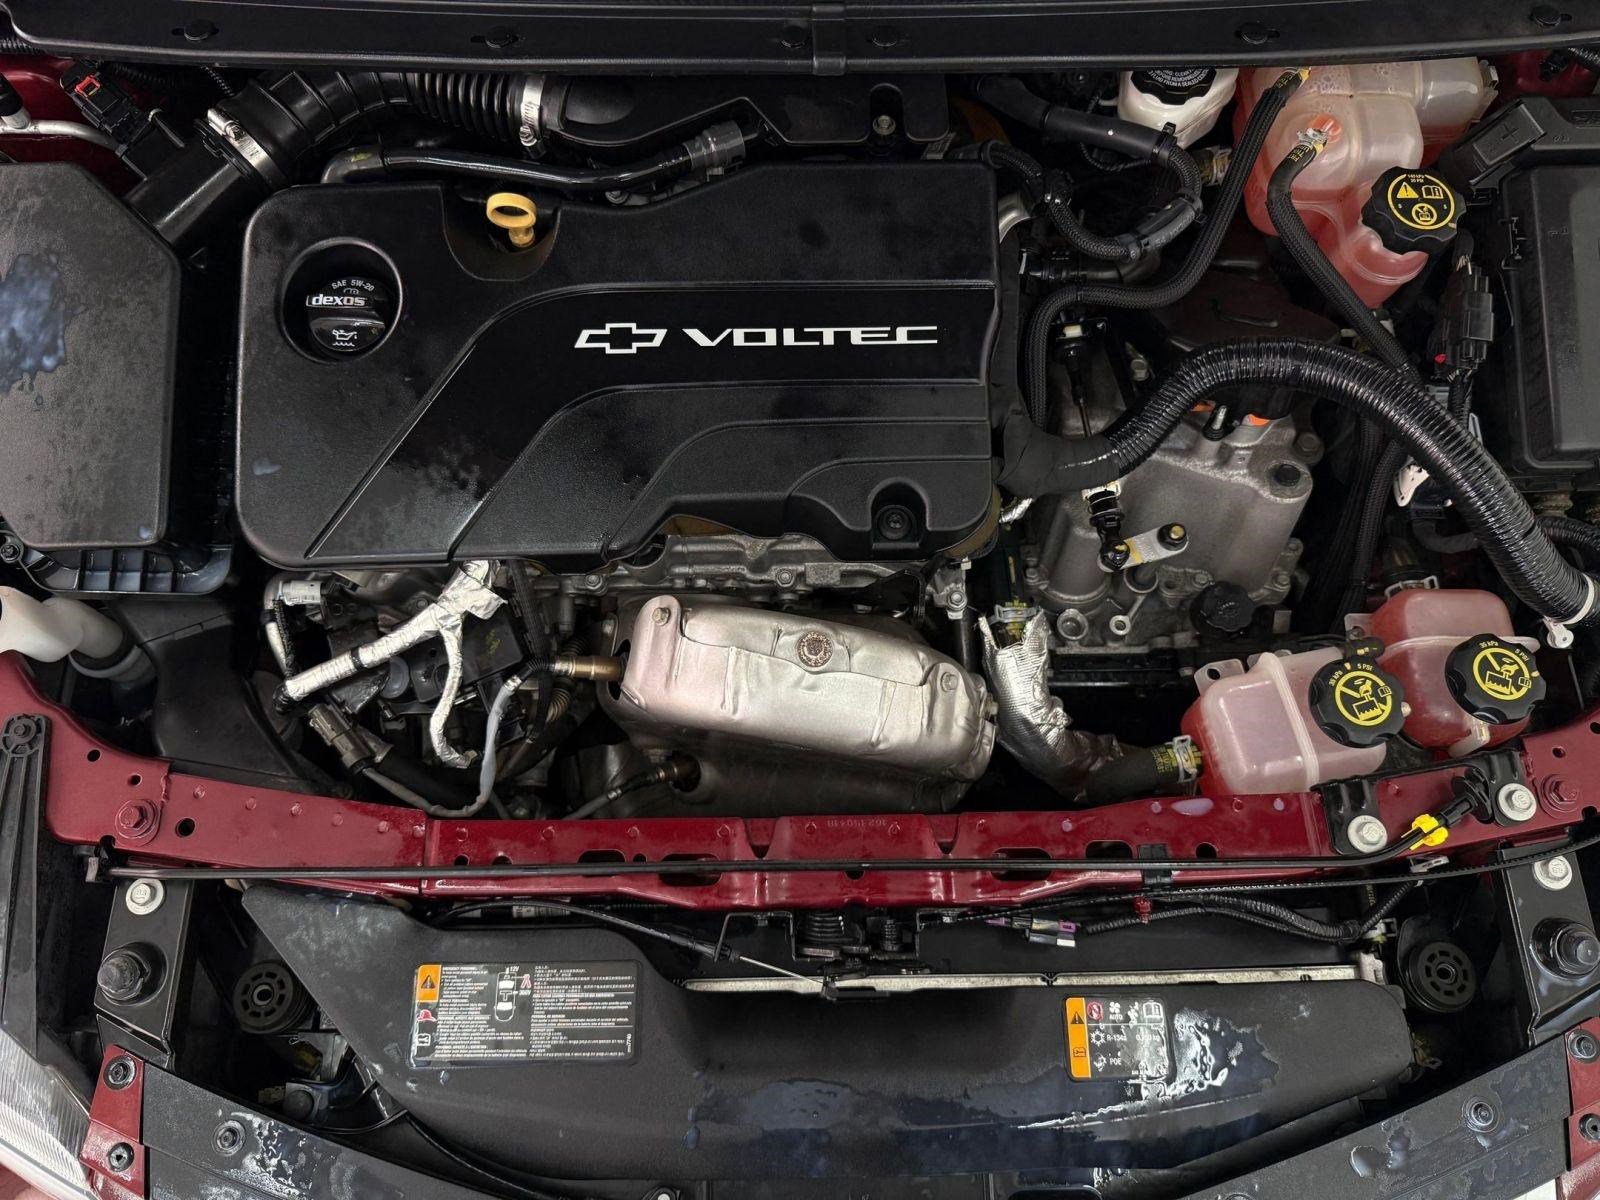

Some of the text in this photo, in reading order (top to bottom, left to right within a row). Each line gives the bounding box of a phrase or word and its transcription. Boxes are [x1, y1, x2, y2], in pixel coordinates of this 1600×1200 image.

[331, 279, 375, 292] SAE 5W-20
[311, 293, 366, 306] dexos
[682, 325, 938, 347] VOLTEC
[1109, 1057, 1122, 1065] POE
